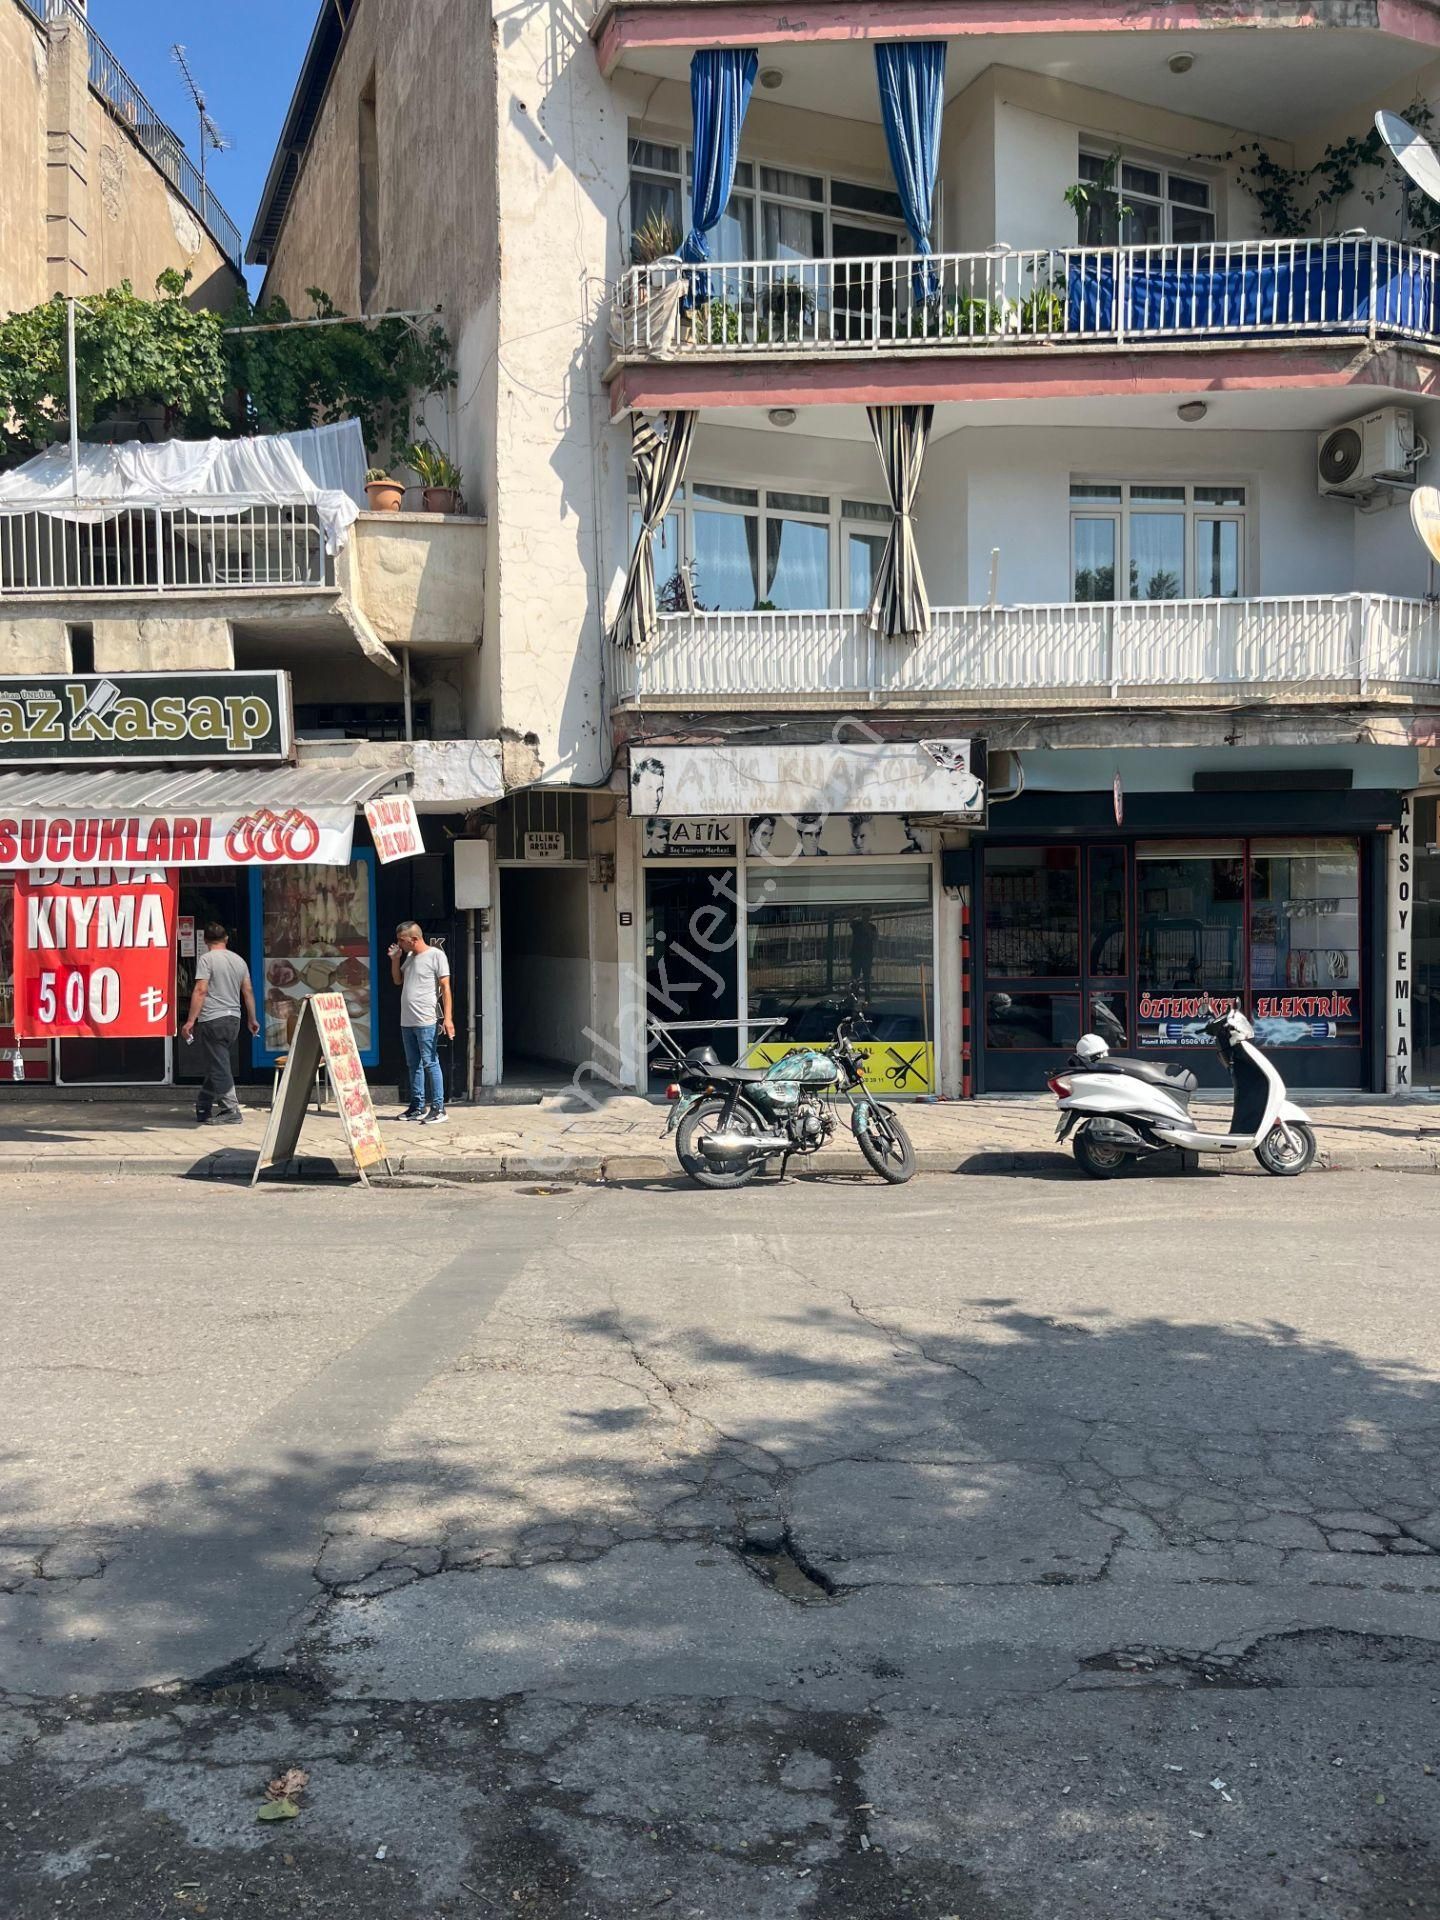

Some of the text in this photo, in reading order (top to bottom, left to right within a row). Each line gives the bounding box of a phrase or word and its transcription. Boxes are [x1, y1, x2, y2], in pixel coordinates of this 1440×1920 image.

[0, 818, 212, 863] SUCUKLARI
[672, 818, 730, 841] ATİK
[1398, 798, 1410, 930] AKSOY
[28, 894, 168, 949] KIYMA
[38, 967, 120, 1024] 500
[1257, 990, 1353, 1017] ELEKTRİK
[1396, 951, 1408, 1084] EMLAK
